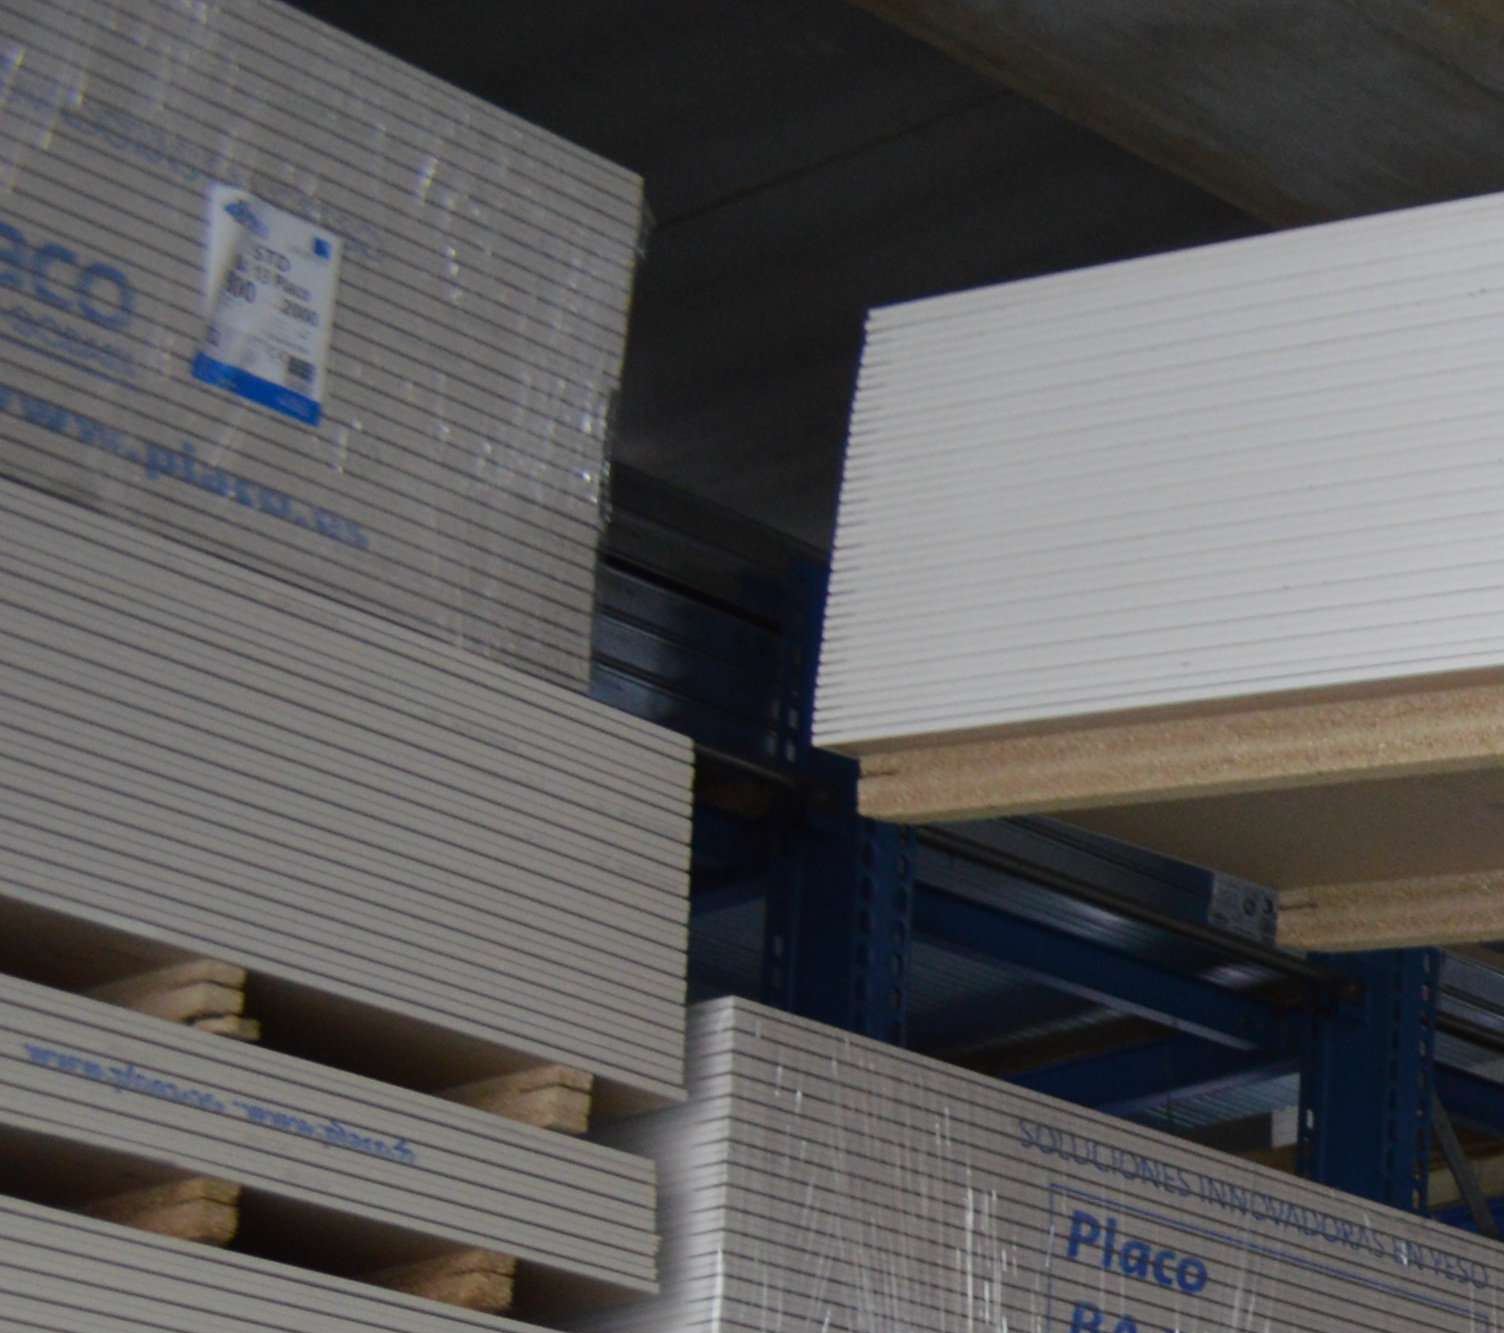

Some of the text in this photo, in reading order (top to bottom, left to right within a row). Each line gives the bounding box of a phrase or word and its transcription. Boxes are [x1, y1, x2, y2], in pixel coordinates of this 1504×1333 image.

[1018, 1117, 1491, 1291] SOLUCIONES INNOVADORAS EN YESO
[1066, 1208, 1209, 1297] Placo
